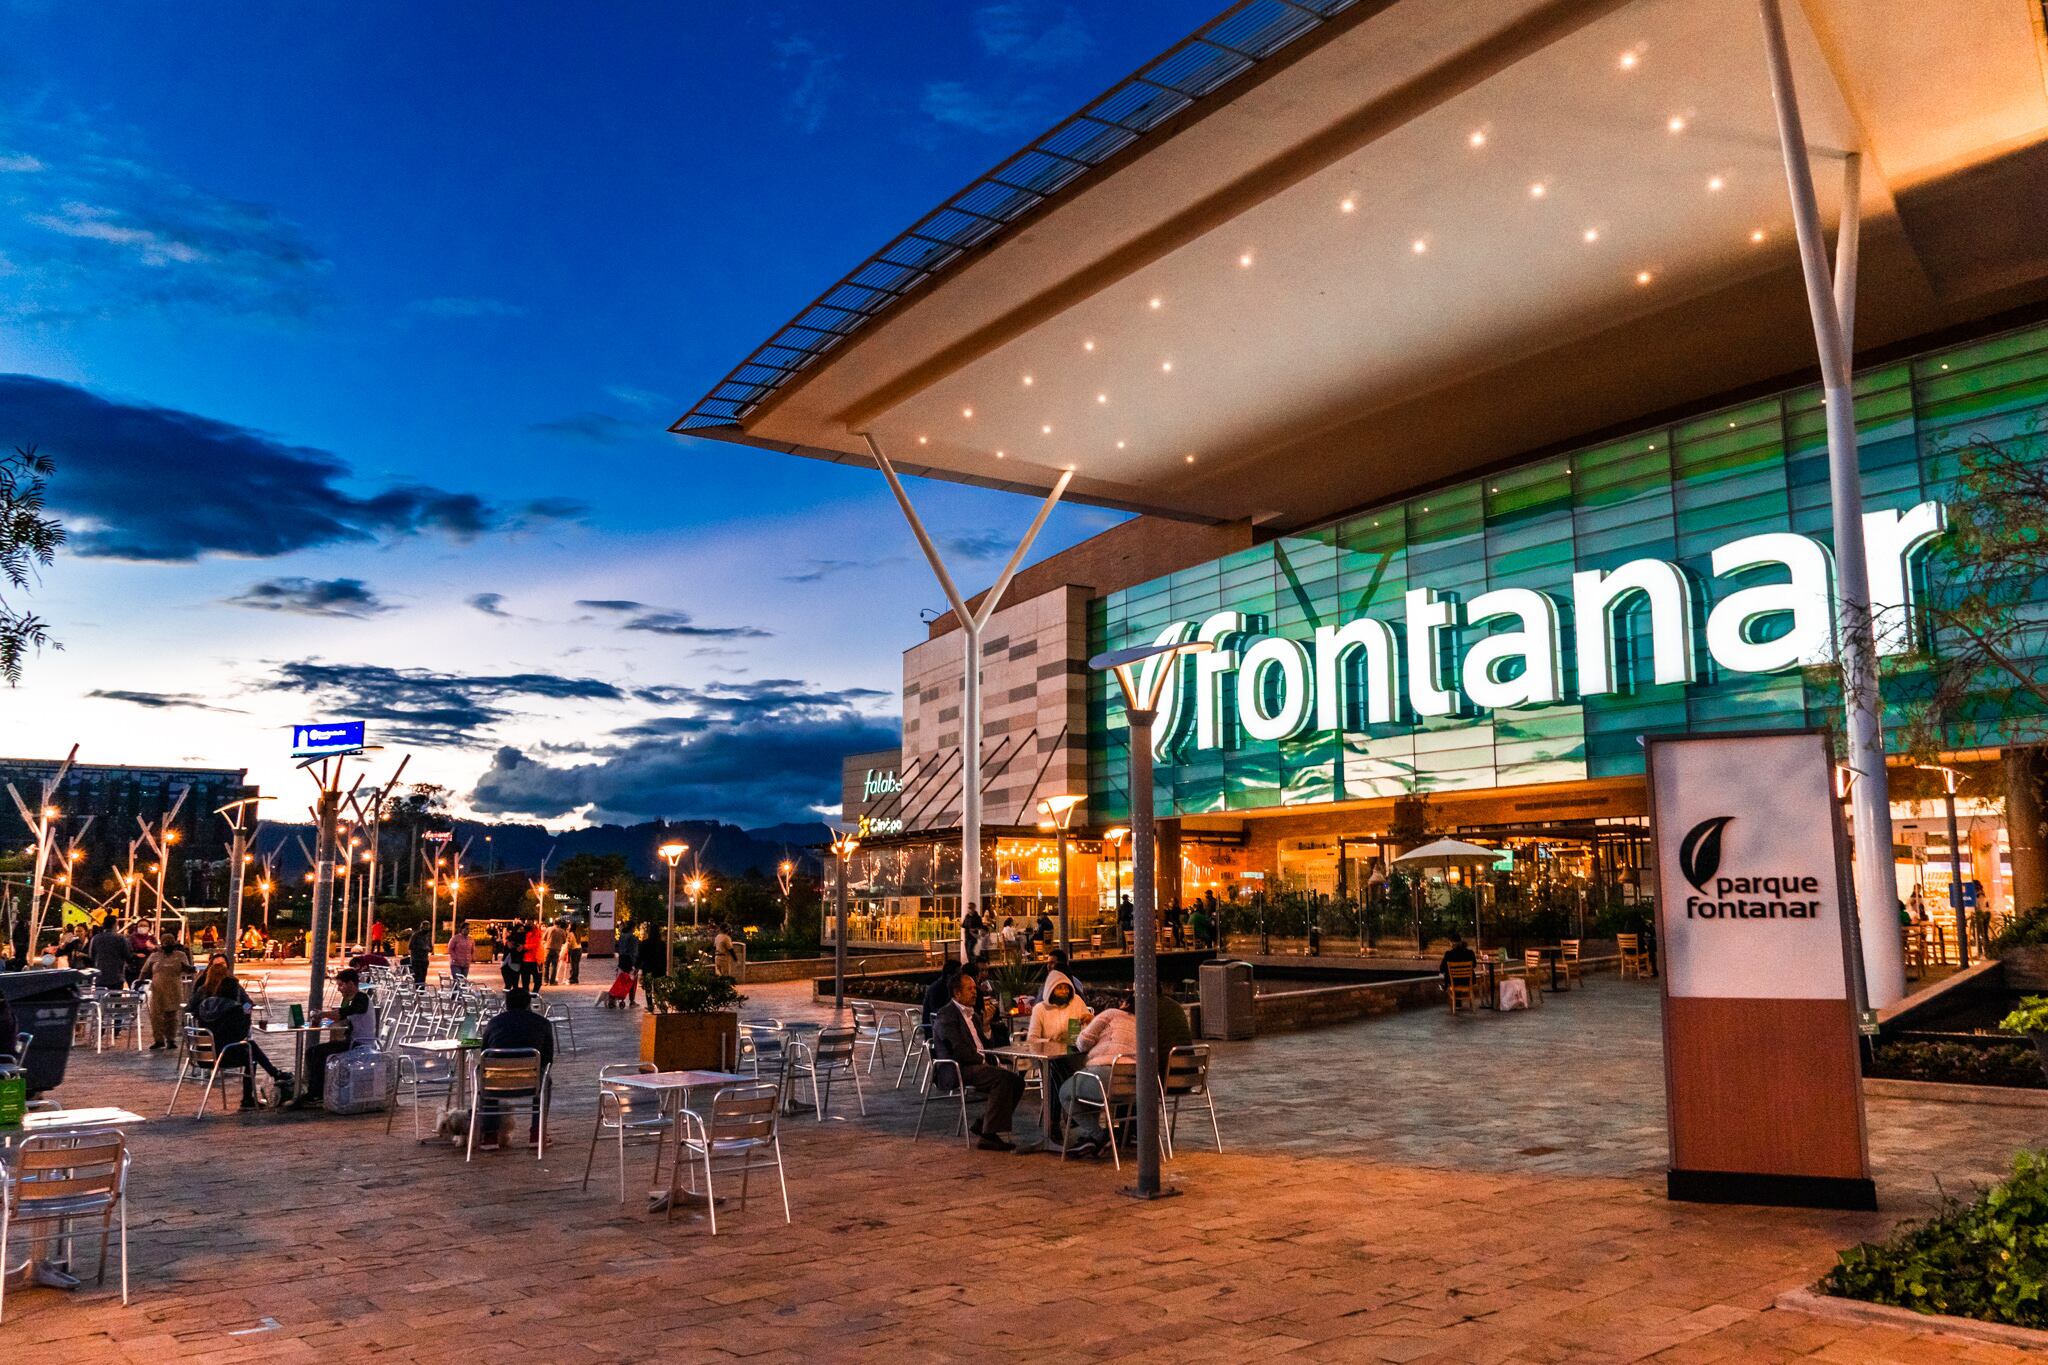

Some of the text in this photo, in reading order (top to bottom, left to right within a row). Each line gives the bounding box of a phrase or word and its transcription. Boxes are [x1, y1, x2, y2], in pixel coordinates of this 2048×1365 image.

[1196, 500, 1948, 750] fontanar
[862, 768, 903, 803] falabe
[870, 818, 903, 834] Cinépo
[1716, 876, 1818, 899] parque
[1686, 896, 1820, 919] fontanar
